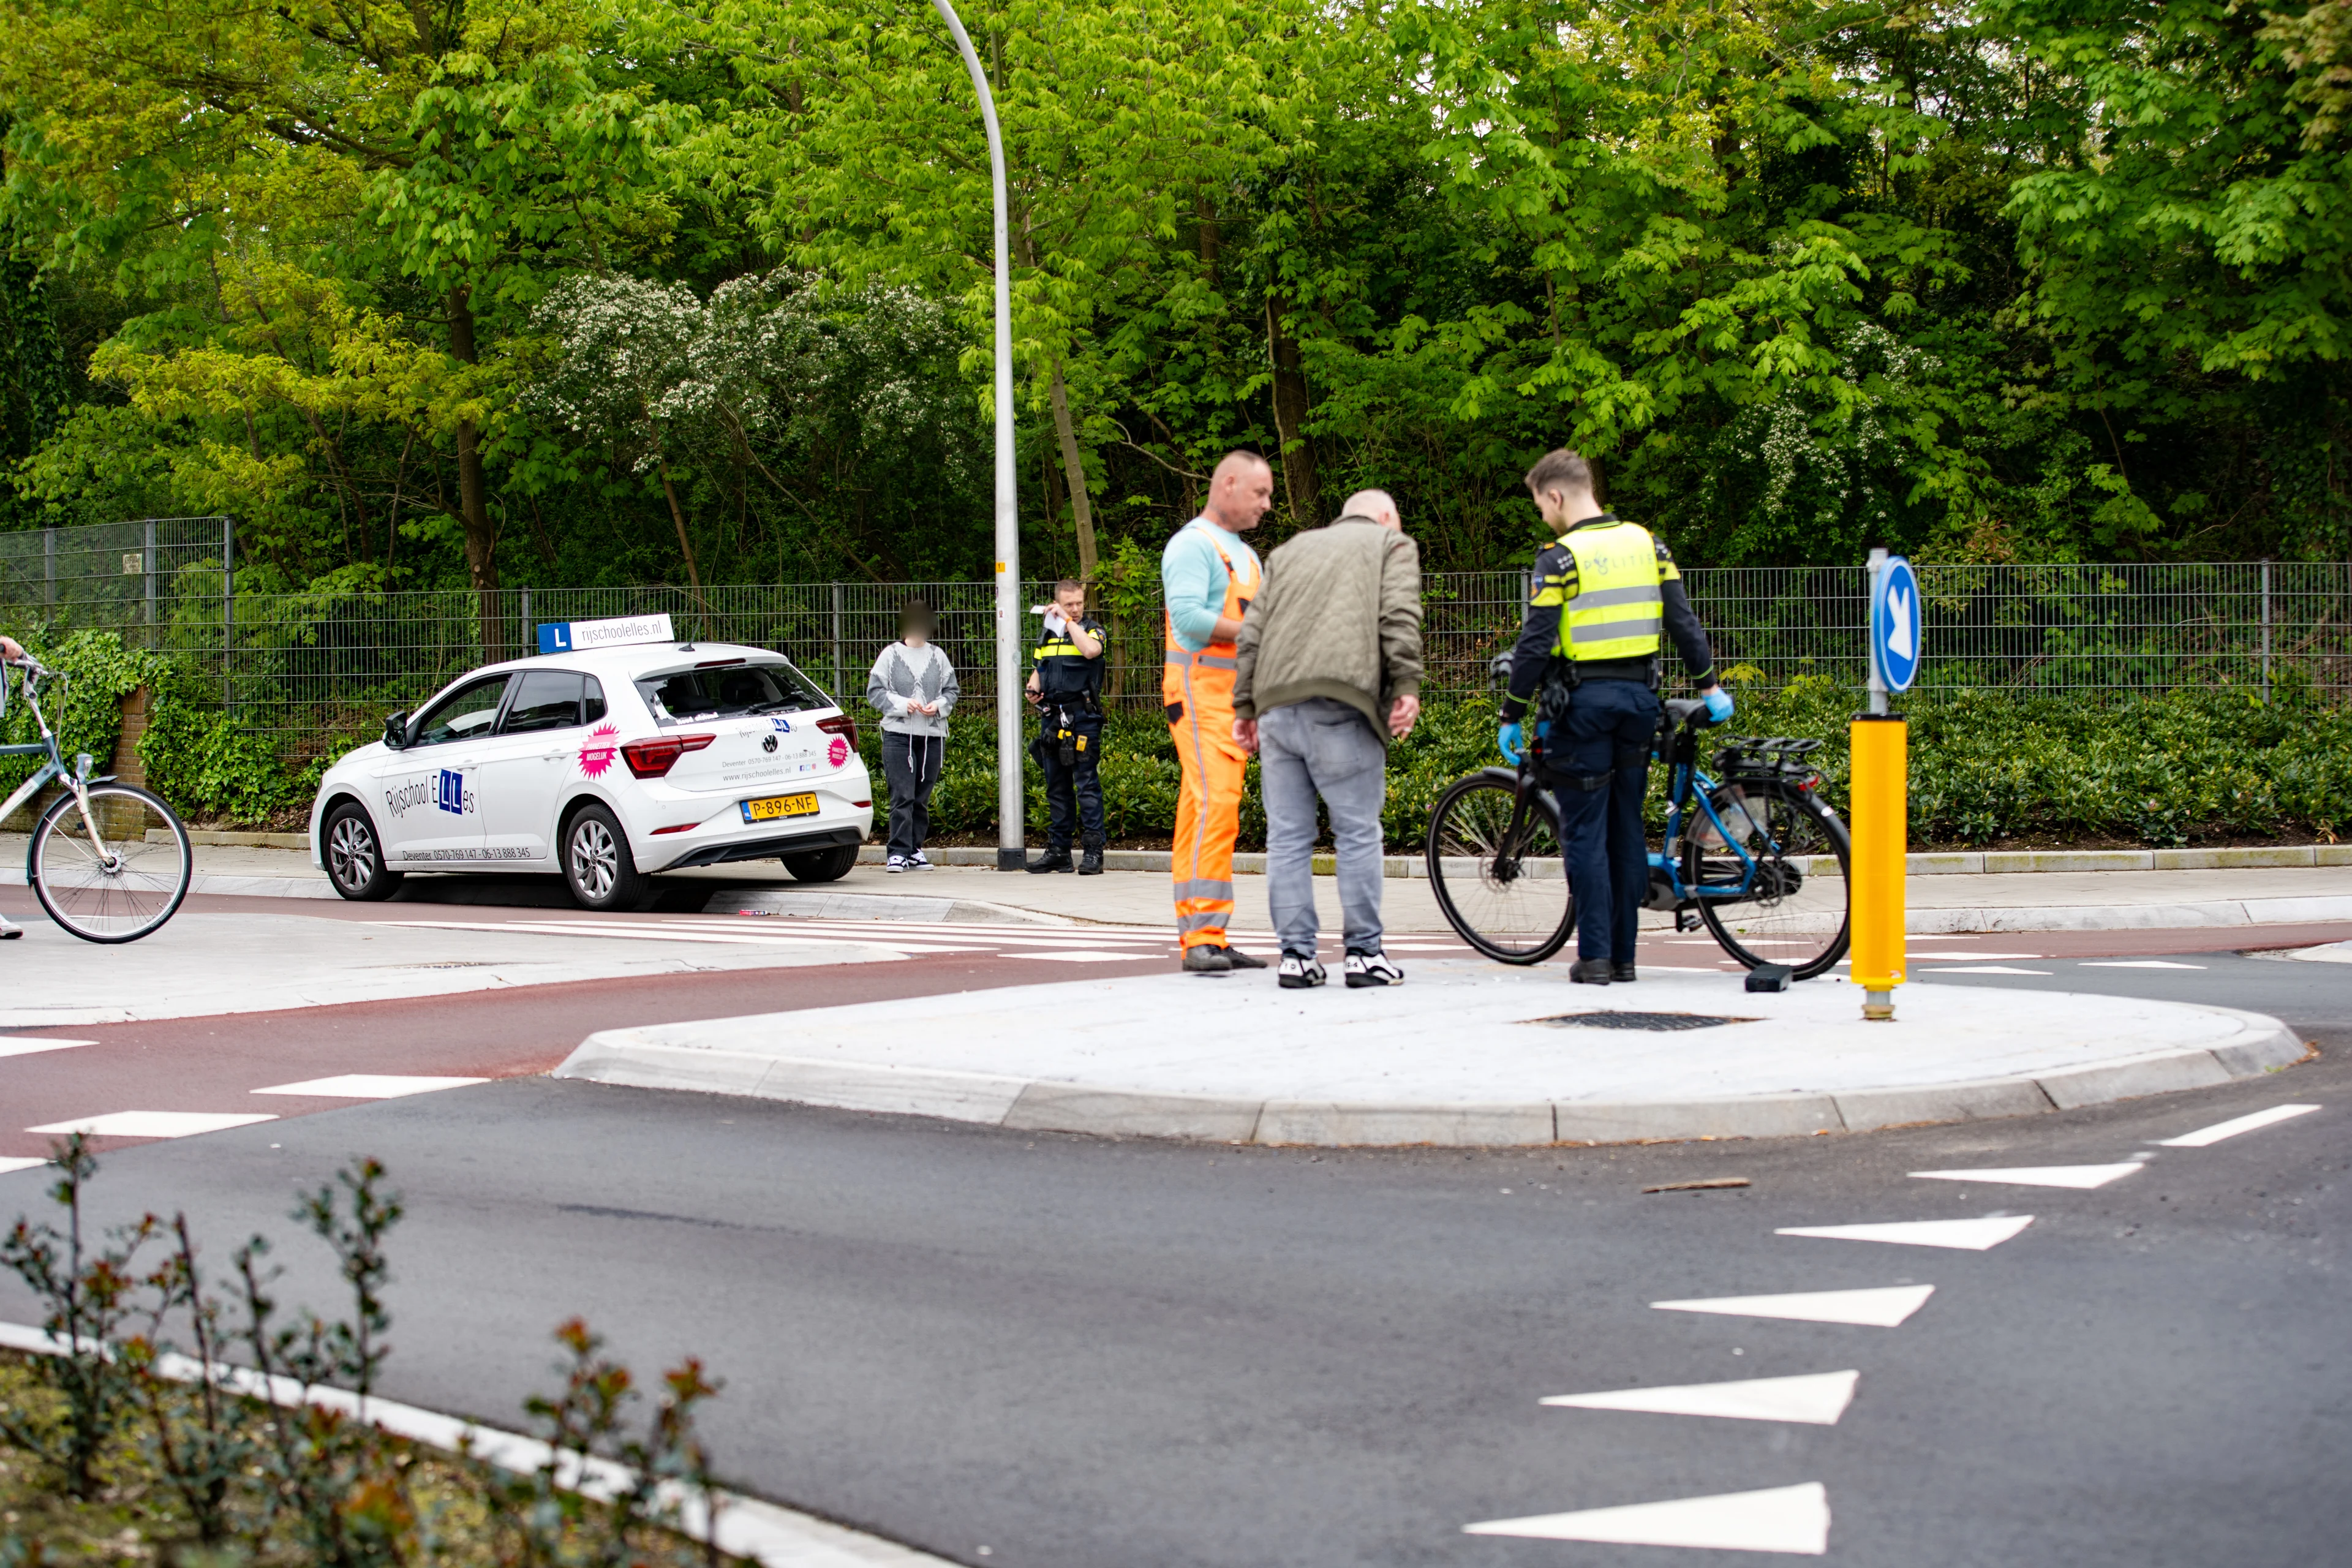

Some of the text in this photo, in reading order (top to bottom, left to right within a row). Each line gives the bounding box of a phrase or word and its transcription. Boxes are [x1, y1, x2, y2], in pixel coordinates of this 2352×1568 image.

[554, 628, 567, 647] L
[582, 620, 662, 644] rijschoolelles.nl
[748, 756, 771, 764] 0570-769
[723, 766, 791, 782] www.rijschoolelles.nl
[385, 775, 429, 818] Rijschool
[753, 796, 812, 816] P-896-NF
[402, 850, 432, 861] Deventer
[434, 850, 464, 860] 0570-769
[464, 849, 476, 859] 147
[482, 848, 502, 859] 06-13
[503, 848, 516, 858] 888
[517, 847, 530, 858] 345
